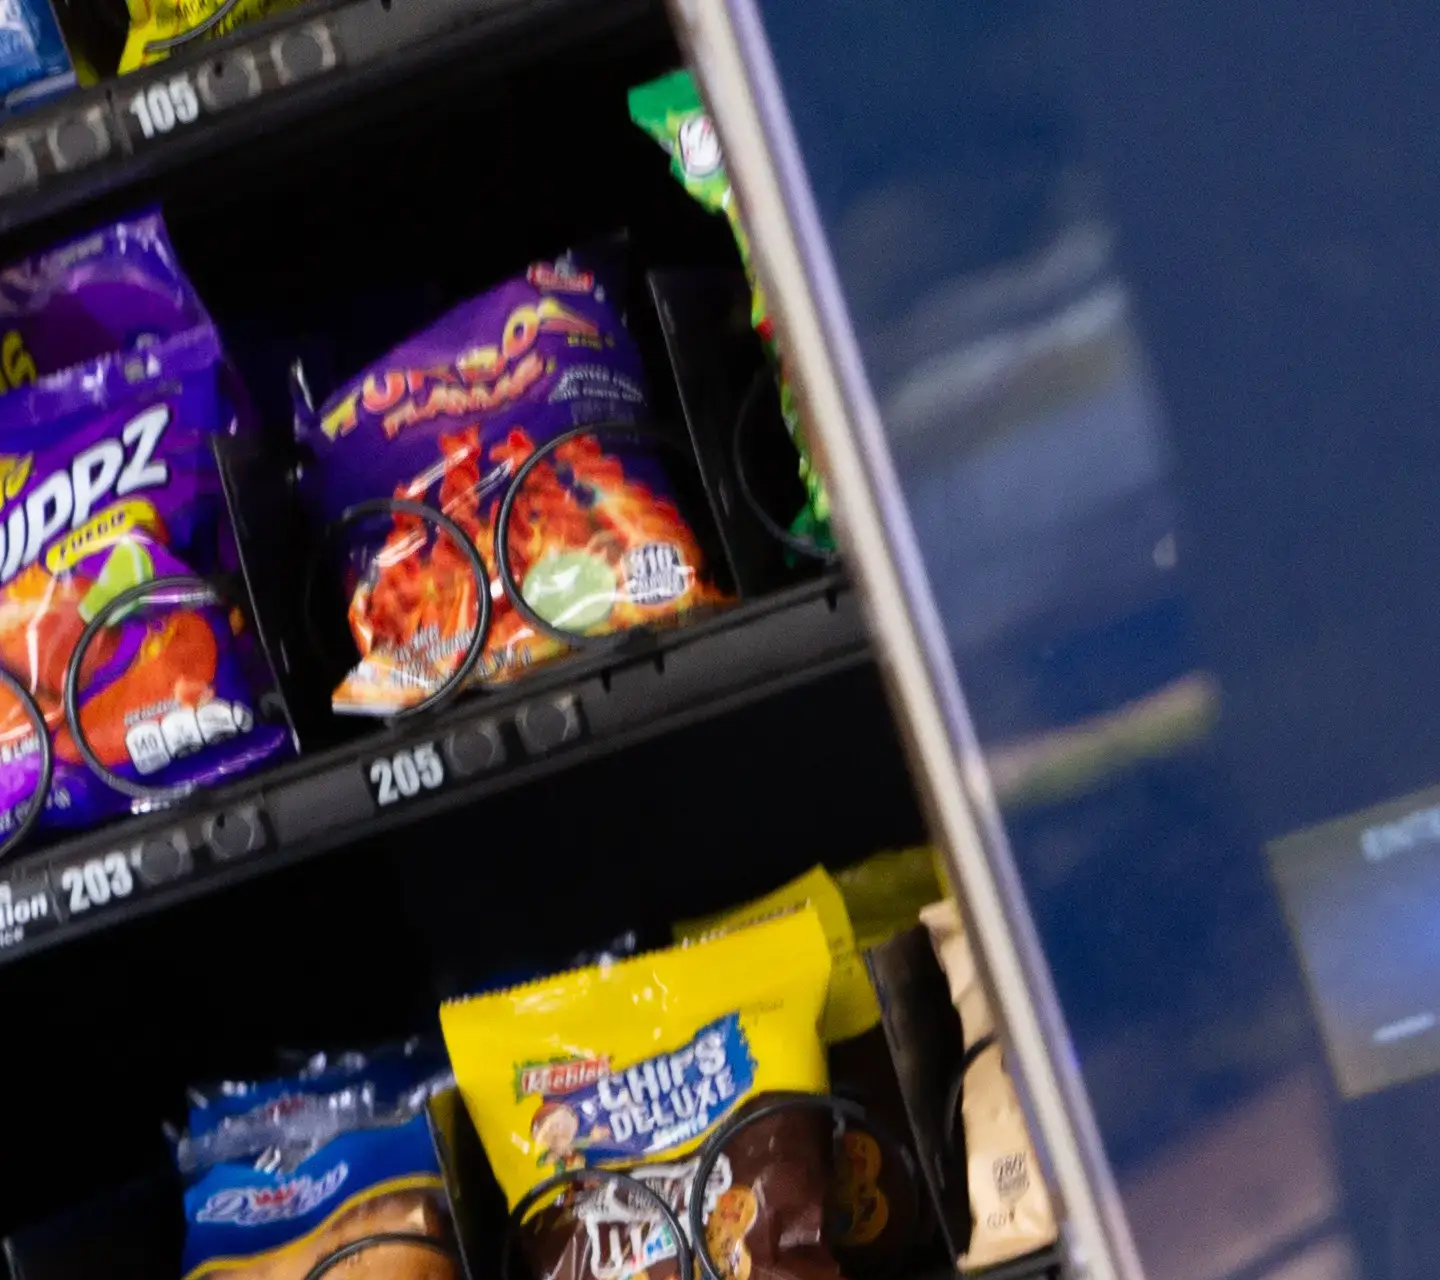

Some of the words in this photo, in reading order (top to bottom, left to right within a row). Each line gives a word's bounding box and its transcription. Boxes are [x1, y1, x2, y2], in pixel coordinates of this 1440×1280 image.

[130, 79, 199, 139] 105
[370, 744, 444, 805] 205
[62, 852, 133, 913] 203
[596, 1030, 726, 1111] CHIPS
[609, 1066, 735, 1143] DELUXE
